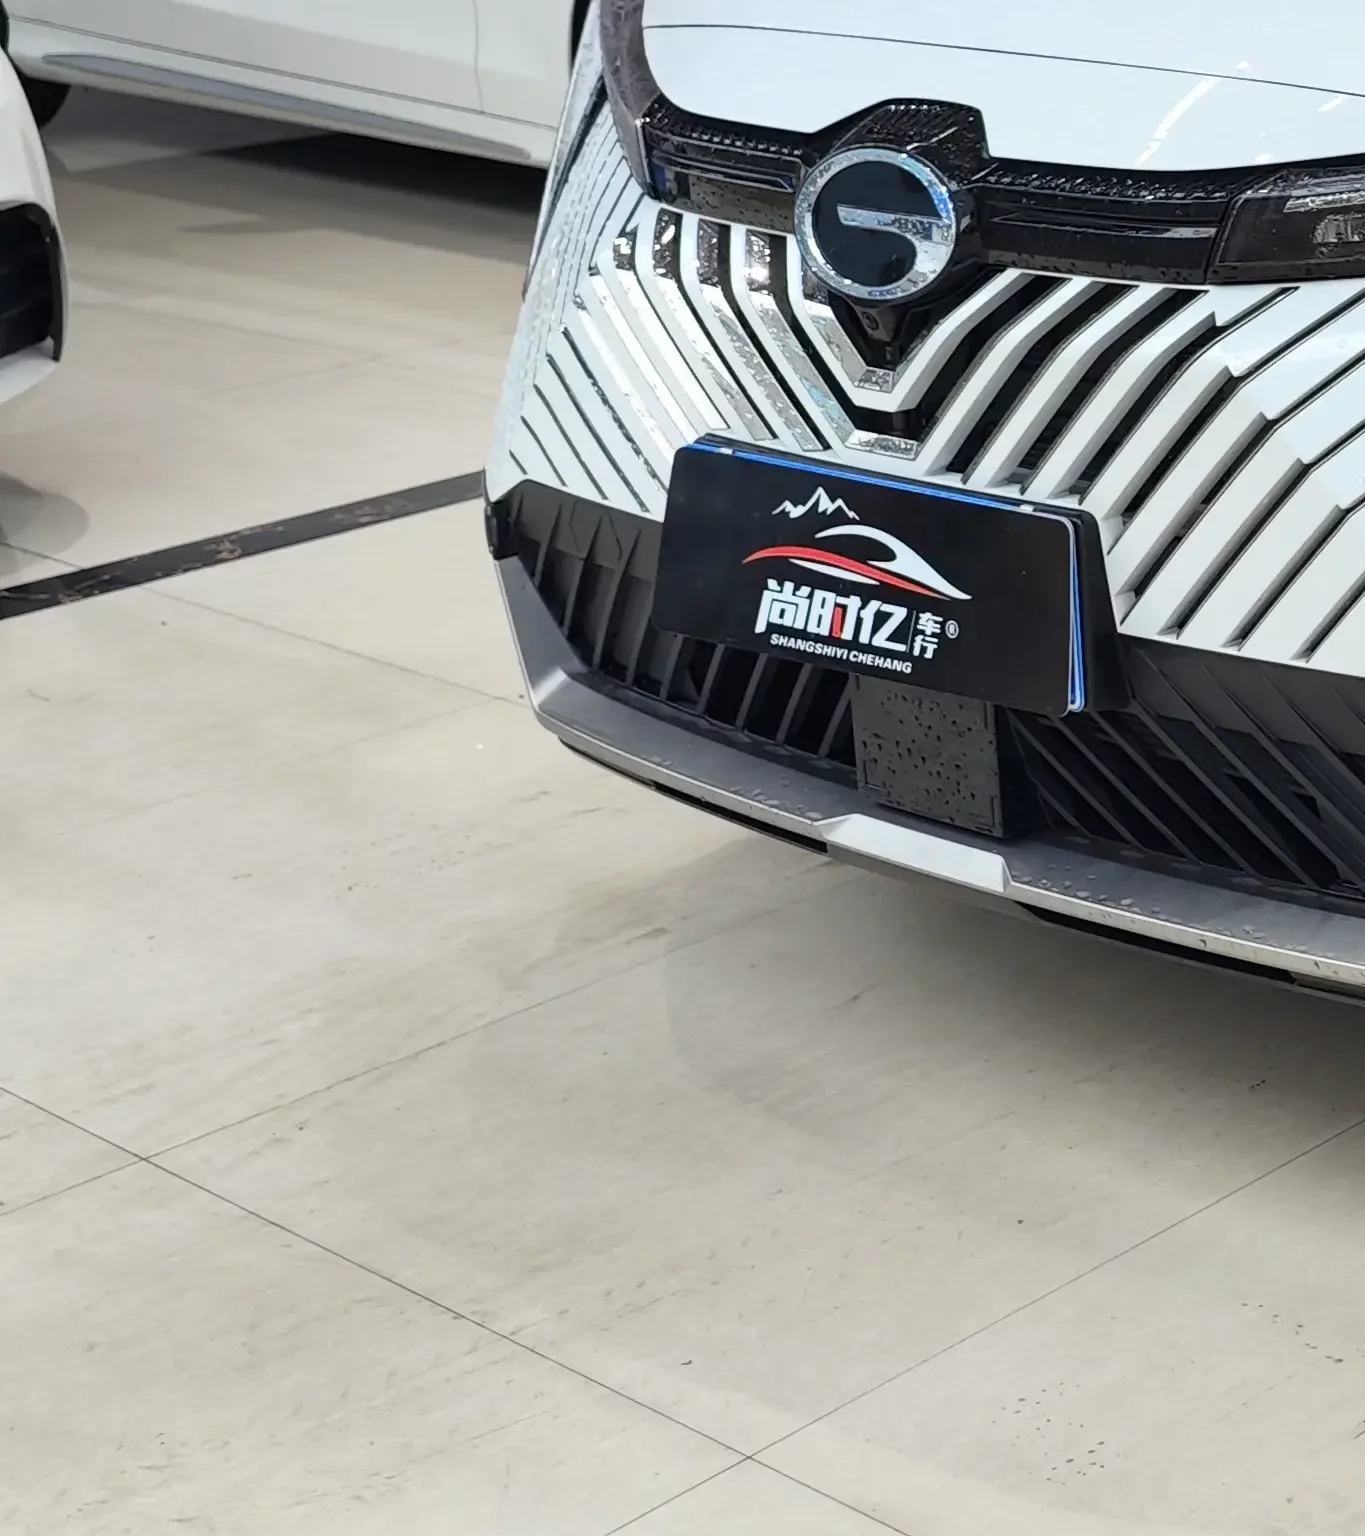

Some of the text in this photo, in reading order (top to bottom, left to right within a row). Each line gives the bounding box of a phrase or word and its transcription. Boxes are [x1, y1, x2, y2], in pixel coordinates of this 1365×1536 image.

[754, 578, 944, 661] 尚时亿 车行
[769, 633, 913, 675] SHANGSHIYI CHEHANG
